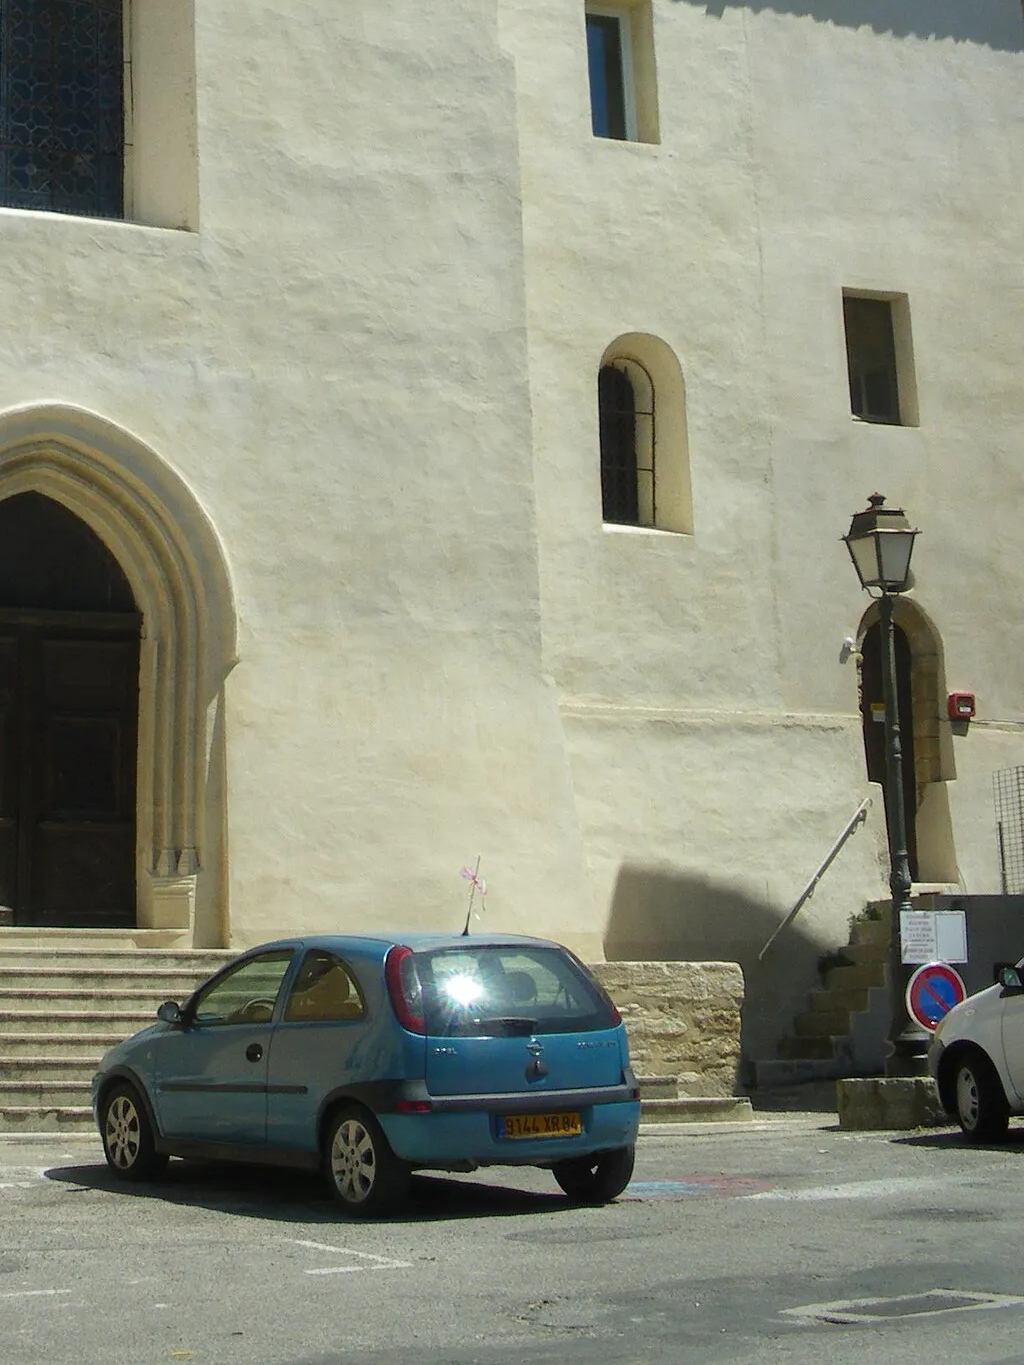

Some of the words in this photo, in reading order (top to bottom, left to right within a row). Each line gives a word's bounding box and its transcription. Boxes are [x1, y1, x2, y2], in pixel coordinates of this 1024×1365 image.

[505, 1117, 540, 1136] 9144
[543, 1115, 560, 1133] XR
[562, 1114, 578, 1132] 84
